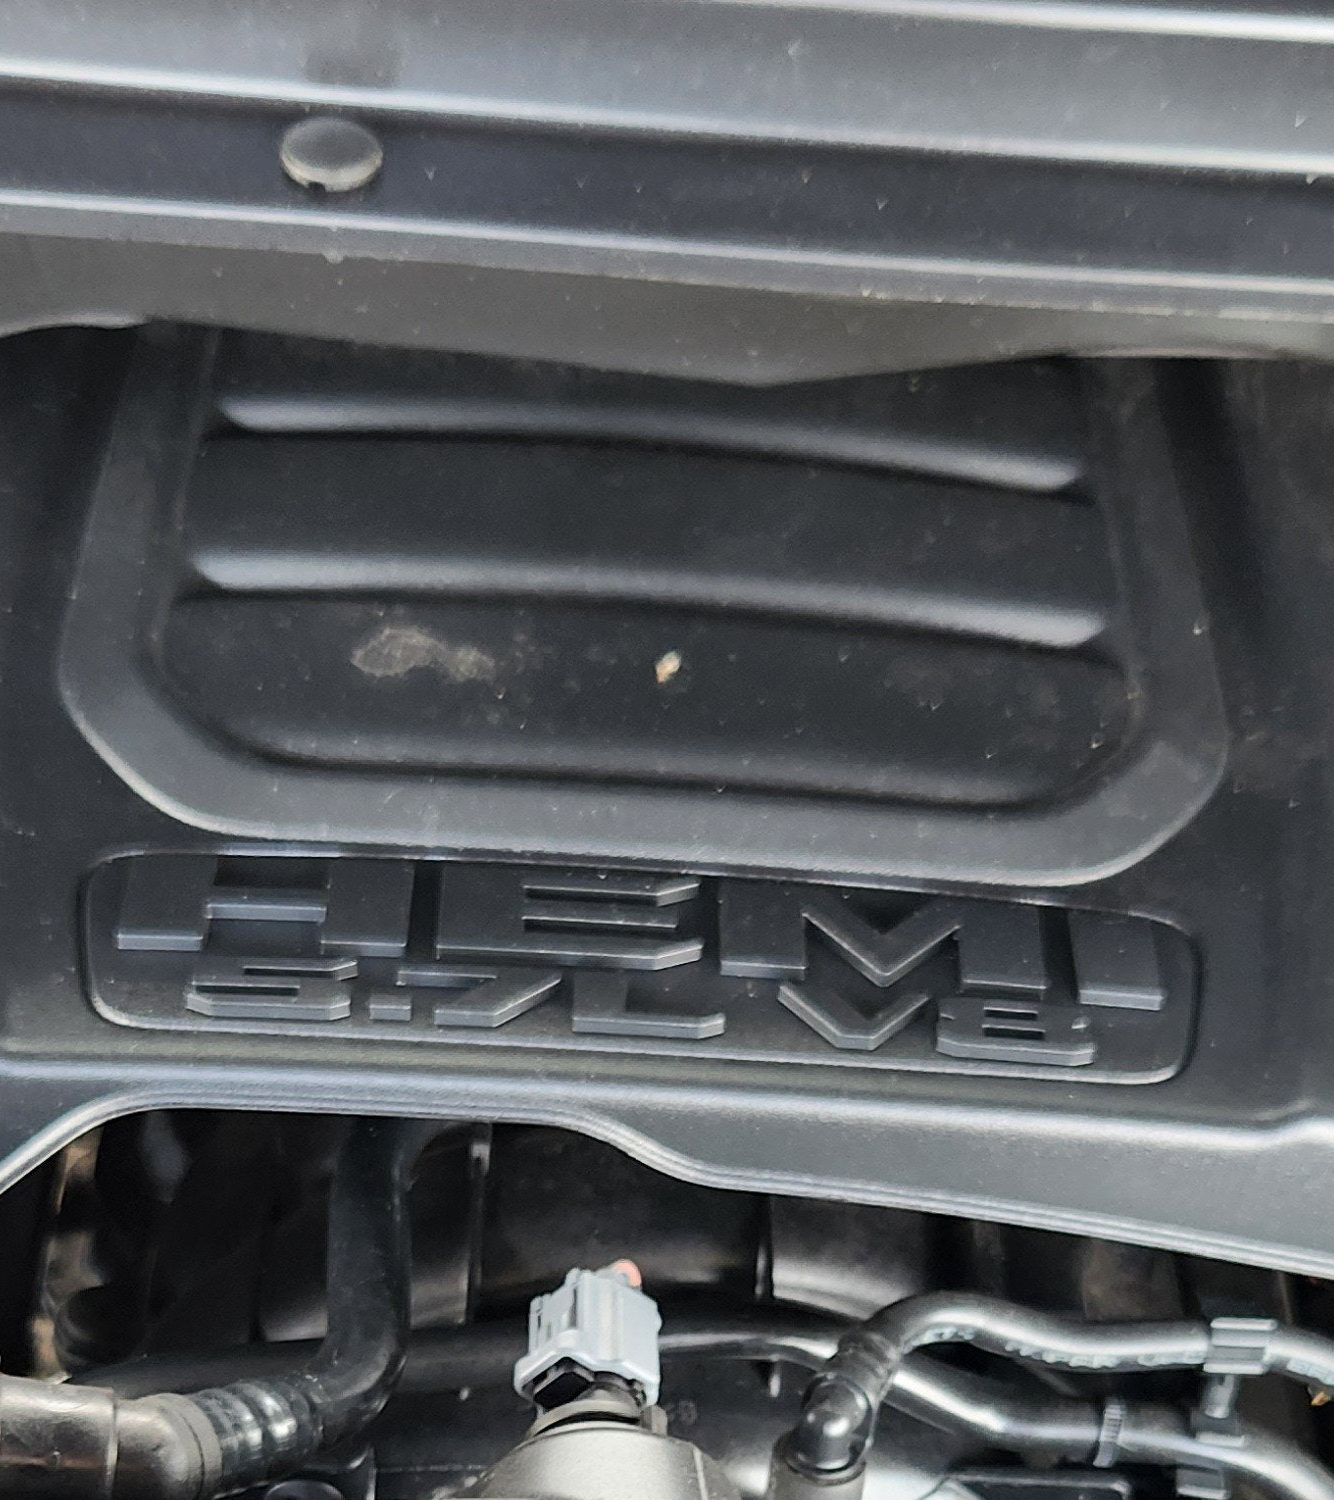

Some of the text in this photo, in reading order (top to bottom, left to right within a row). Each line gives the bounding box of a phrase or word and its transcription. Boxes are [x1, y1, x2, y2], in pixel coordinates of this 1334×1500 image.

[116, 855, 1165, 1011] HEMI
[185, 956, 1096, 1066] 5.7L V8
